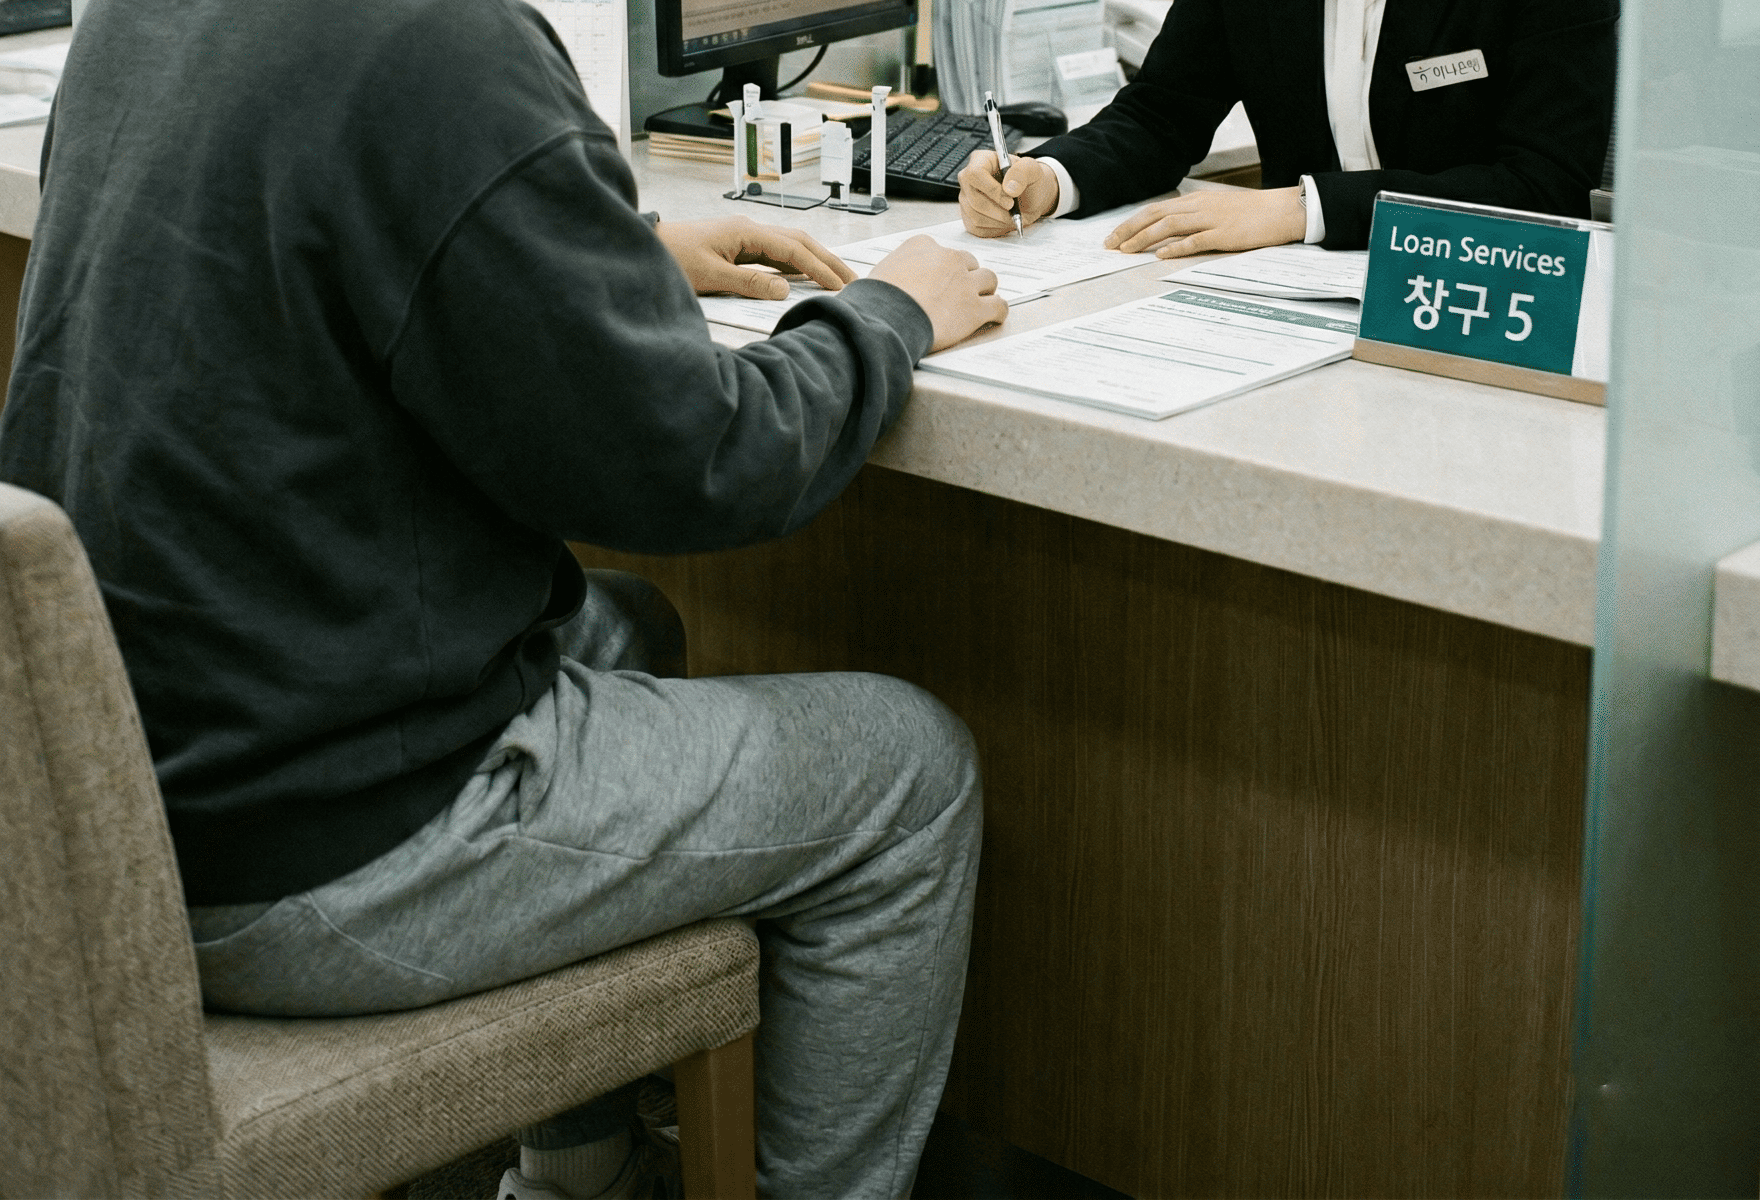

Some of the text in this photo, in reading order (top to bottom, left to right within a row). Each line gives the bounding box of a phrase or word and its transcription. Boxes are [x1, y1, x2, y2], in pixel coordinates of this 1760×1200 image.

[1390, 225, 1566, 277] Loan Services
[1403, 274, 1535, 342] 창구 5
